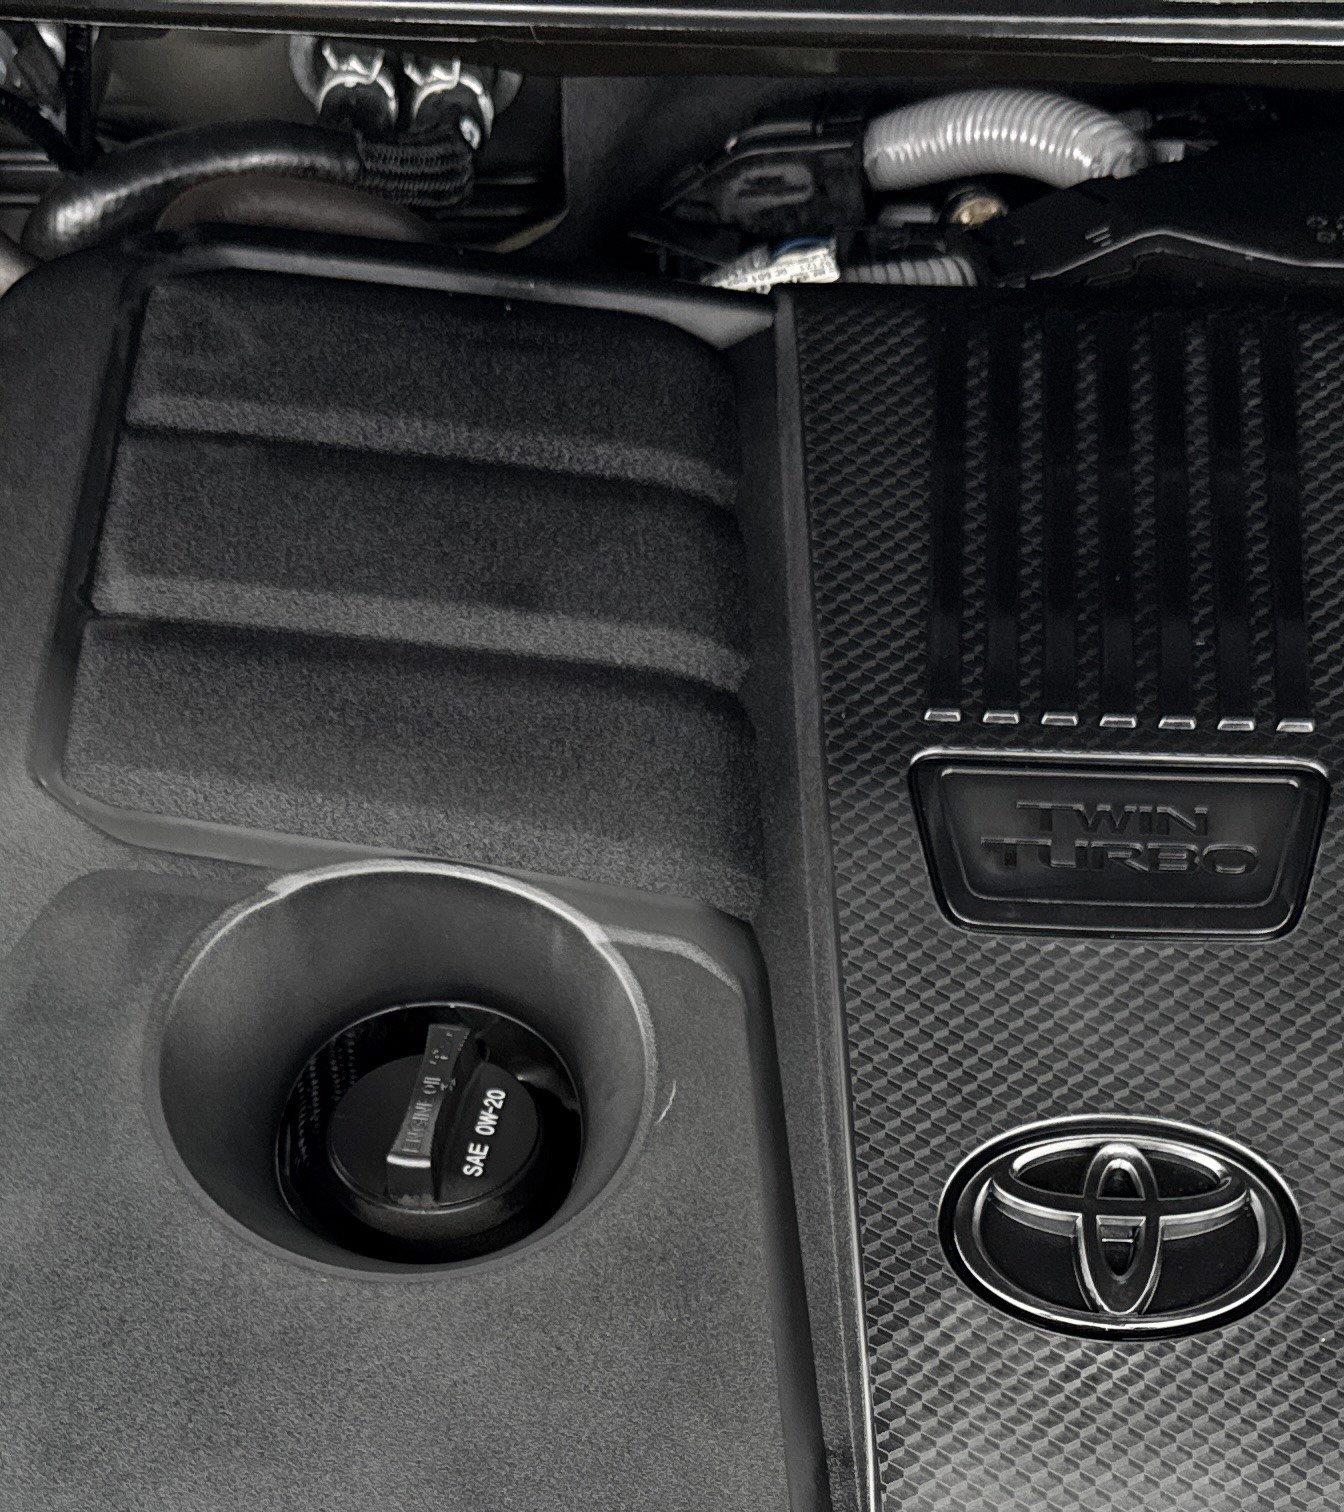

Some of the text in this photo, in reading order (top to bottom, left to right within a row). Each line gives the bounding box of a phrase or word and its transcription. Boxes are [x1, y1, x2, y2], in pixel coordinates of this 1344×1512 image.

[1014, 799, 1209, 839] TWIN
[980, 837, 1258, 876] TURBO
[462, 1088, 506, 1178] SAE 0W-20
